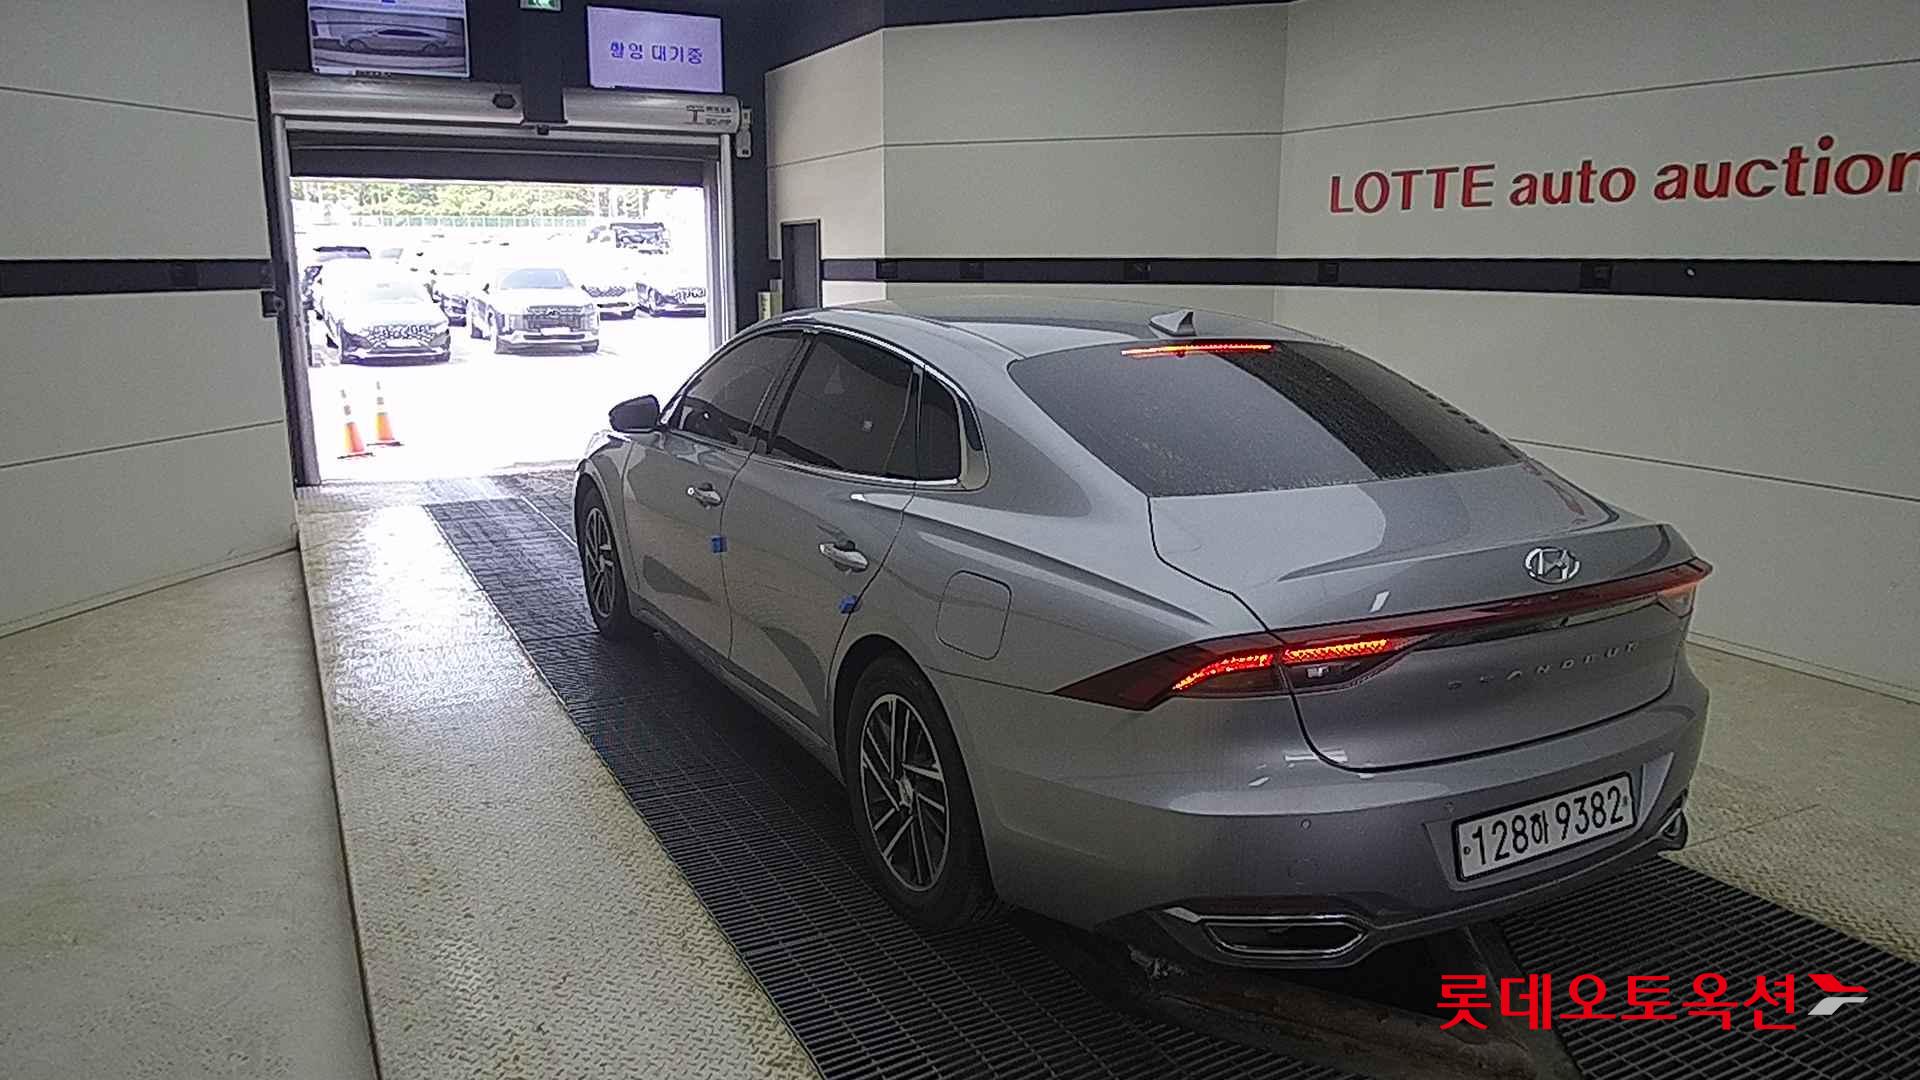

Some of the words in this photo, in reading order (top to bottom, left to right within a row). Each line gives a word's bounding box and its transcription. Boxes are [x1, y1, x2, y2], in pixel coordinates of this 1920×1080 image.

[651, 44, 703, 65] 대기중
[1330, 163, 1496, 214] LOTTE
[1509, 159, 1637, 206] auto
[1555, 785, 1624, 842] 9382
